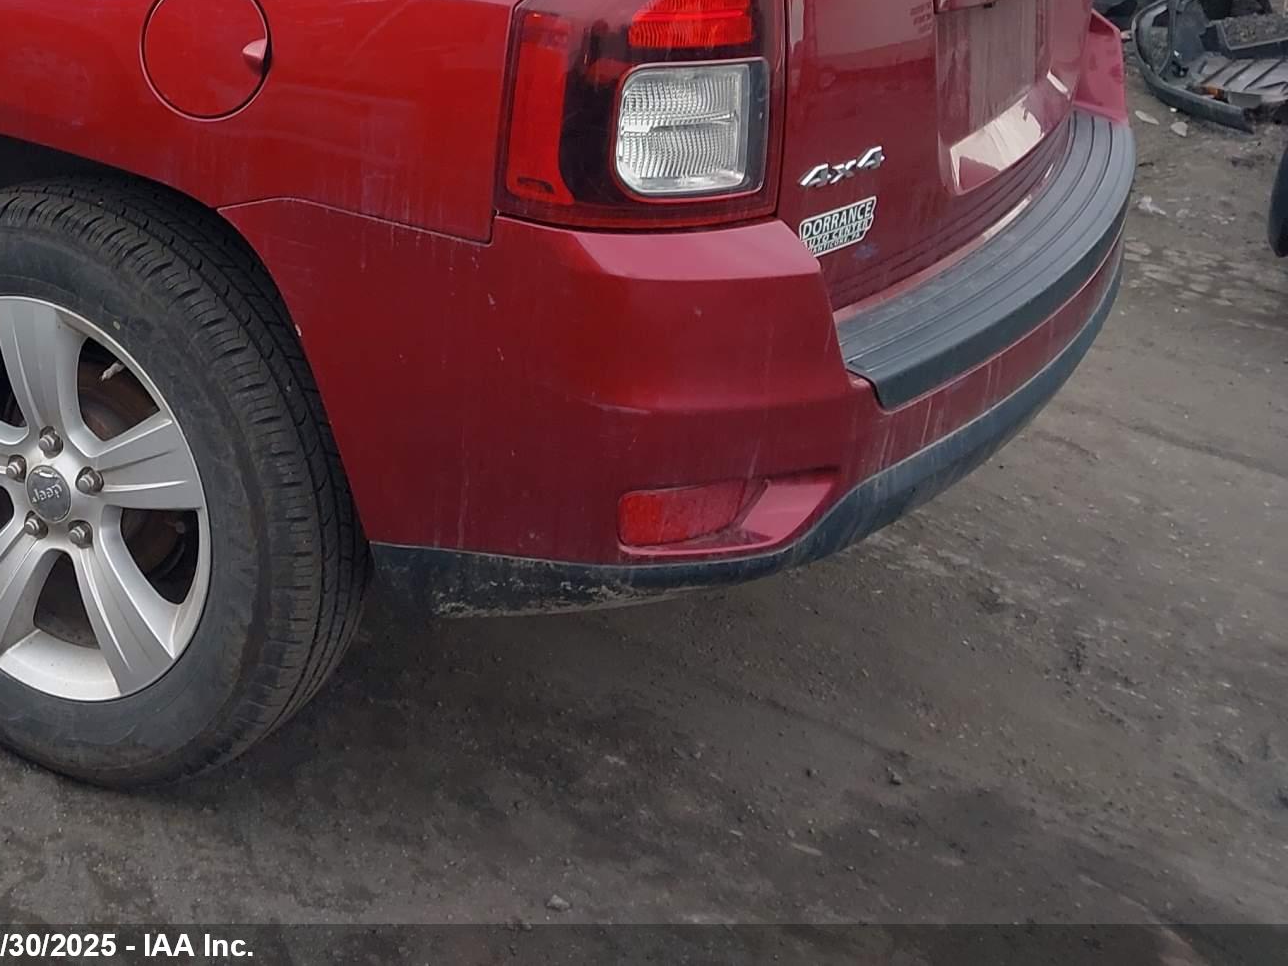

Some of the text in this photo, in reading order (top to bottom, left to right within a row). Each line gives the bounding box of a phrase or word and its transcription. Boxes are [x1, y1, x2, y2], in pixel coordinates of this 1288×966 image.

[798, 145, 885, 187] 4x4
[802, 201, 873, 239] DORRANCE
[31, 483, 63, 503] Jeep
